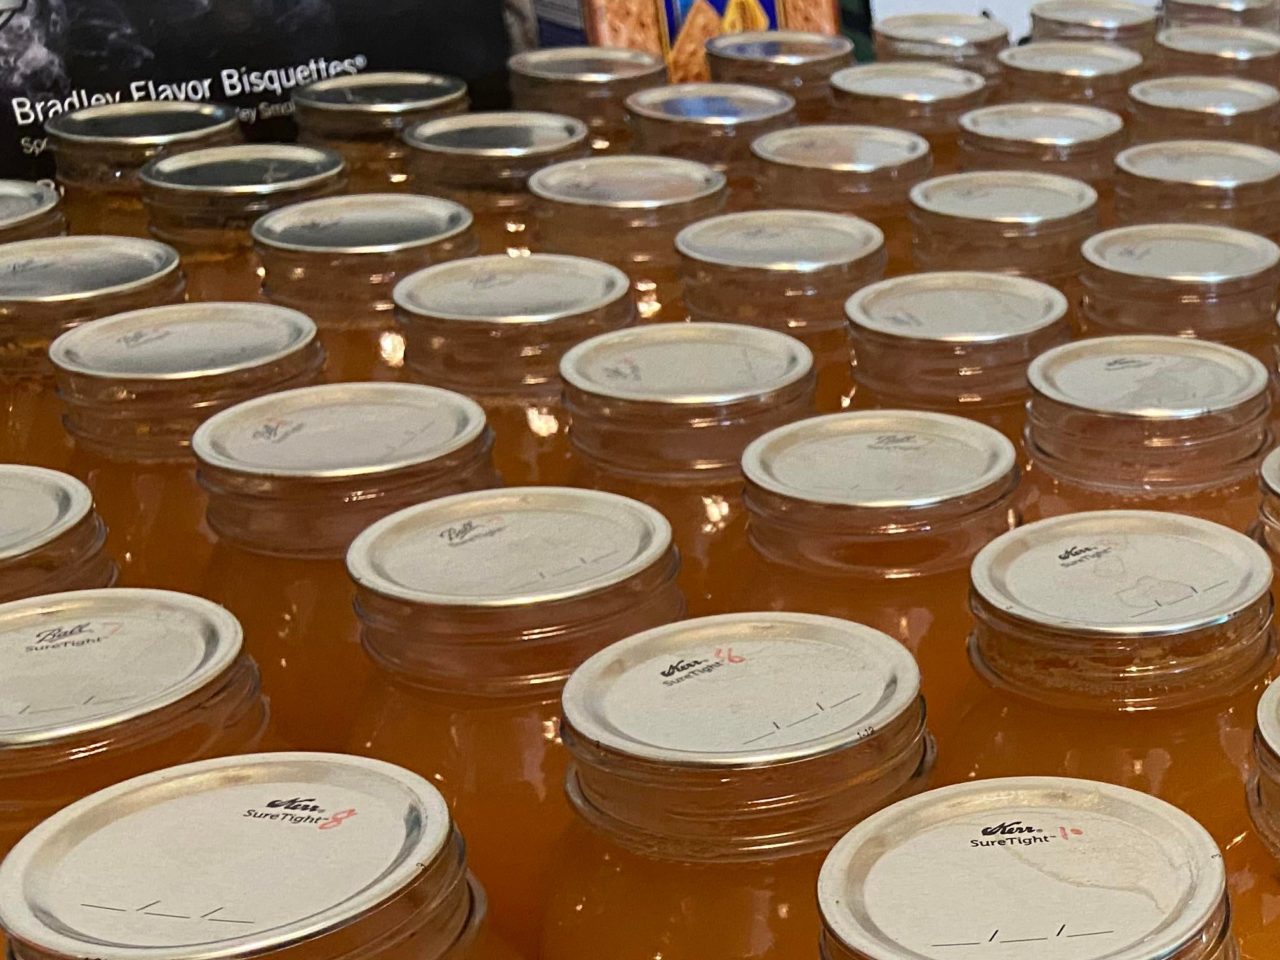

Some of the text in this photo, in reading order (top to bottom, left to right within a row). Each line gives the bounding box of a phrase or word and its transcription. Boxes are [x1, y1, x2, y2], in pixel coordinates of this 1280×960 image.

[130, 79, 212, 101] Flavor
[36, 622, 92, 644] Ball
[243, 809, 323, 824] SureTight
[981, 820, 1035, 836] Kerr
[970, 835, 1050, 847] SureTight
